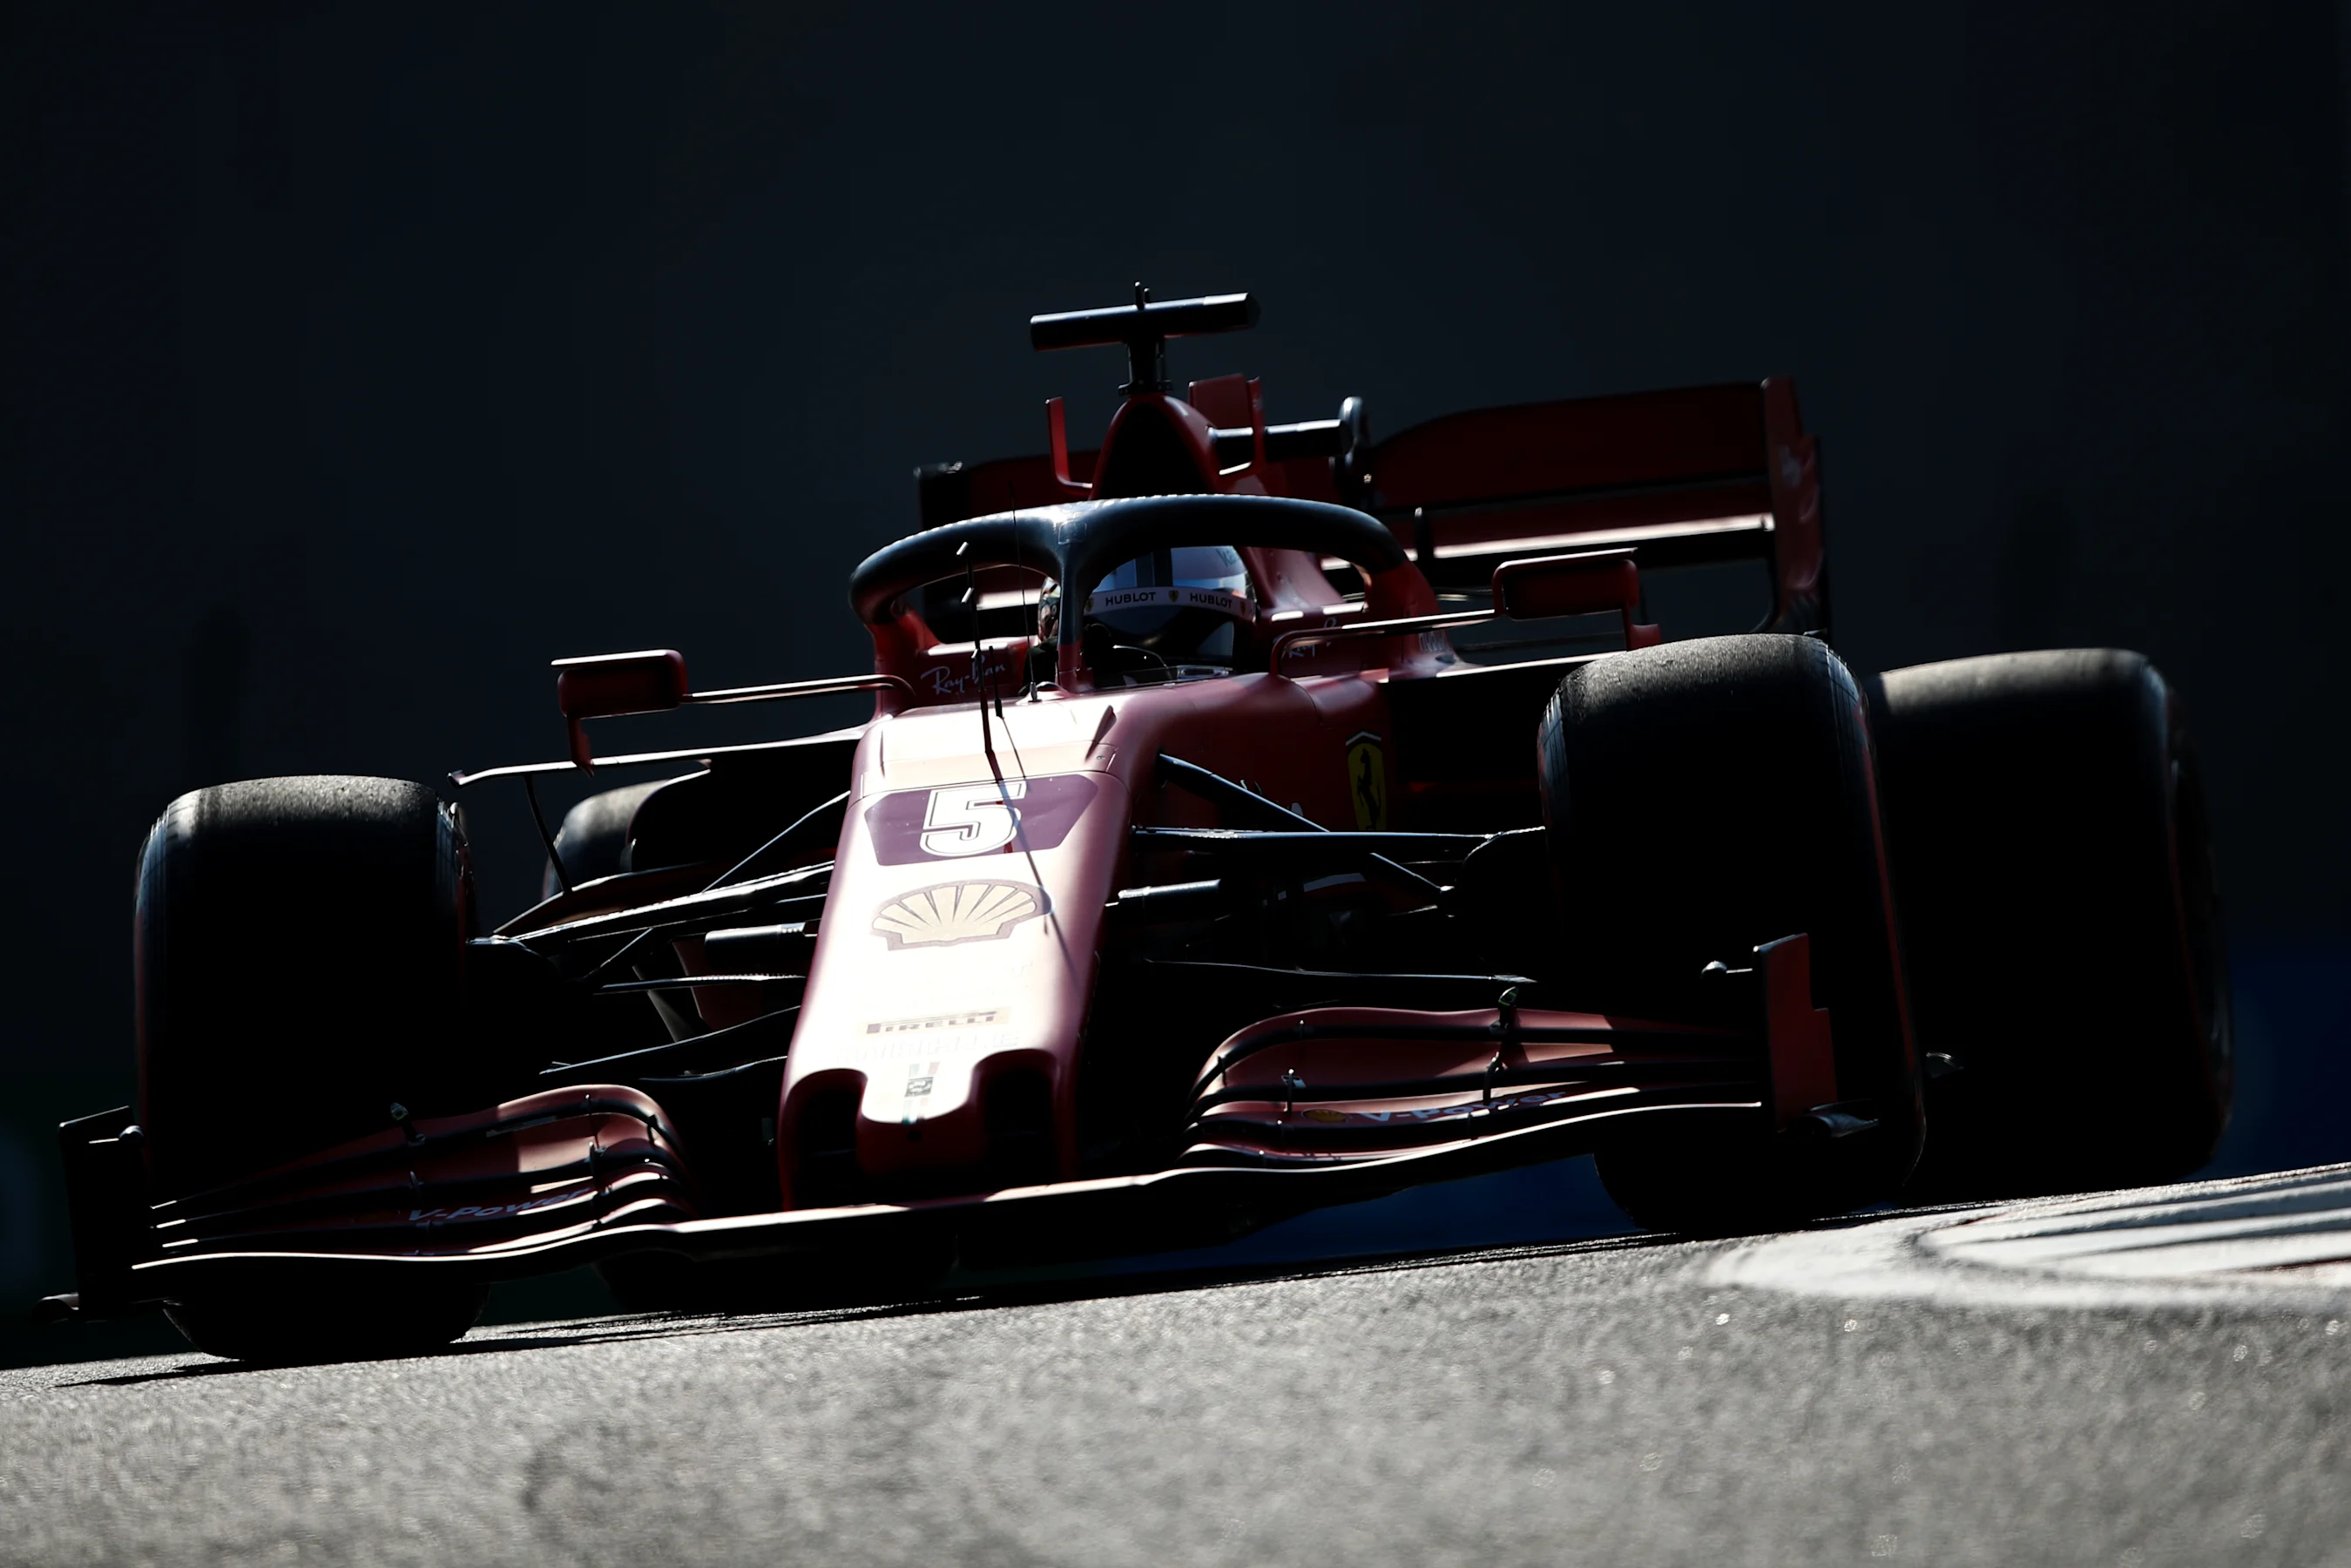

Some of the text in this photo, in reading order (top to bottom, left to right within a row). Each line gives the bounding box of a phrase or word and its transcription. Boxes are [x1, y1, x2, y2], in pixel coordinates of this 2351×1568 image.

[1105, 591, 1157, 606] HUBLOT
[1190, 592, 1233, 608] HUBLOT
[920, 781, 1027, 857] 5
